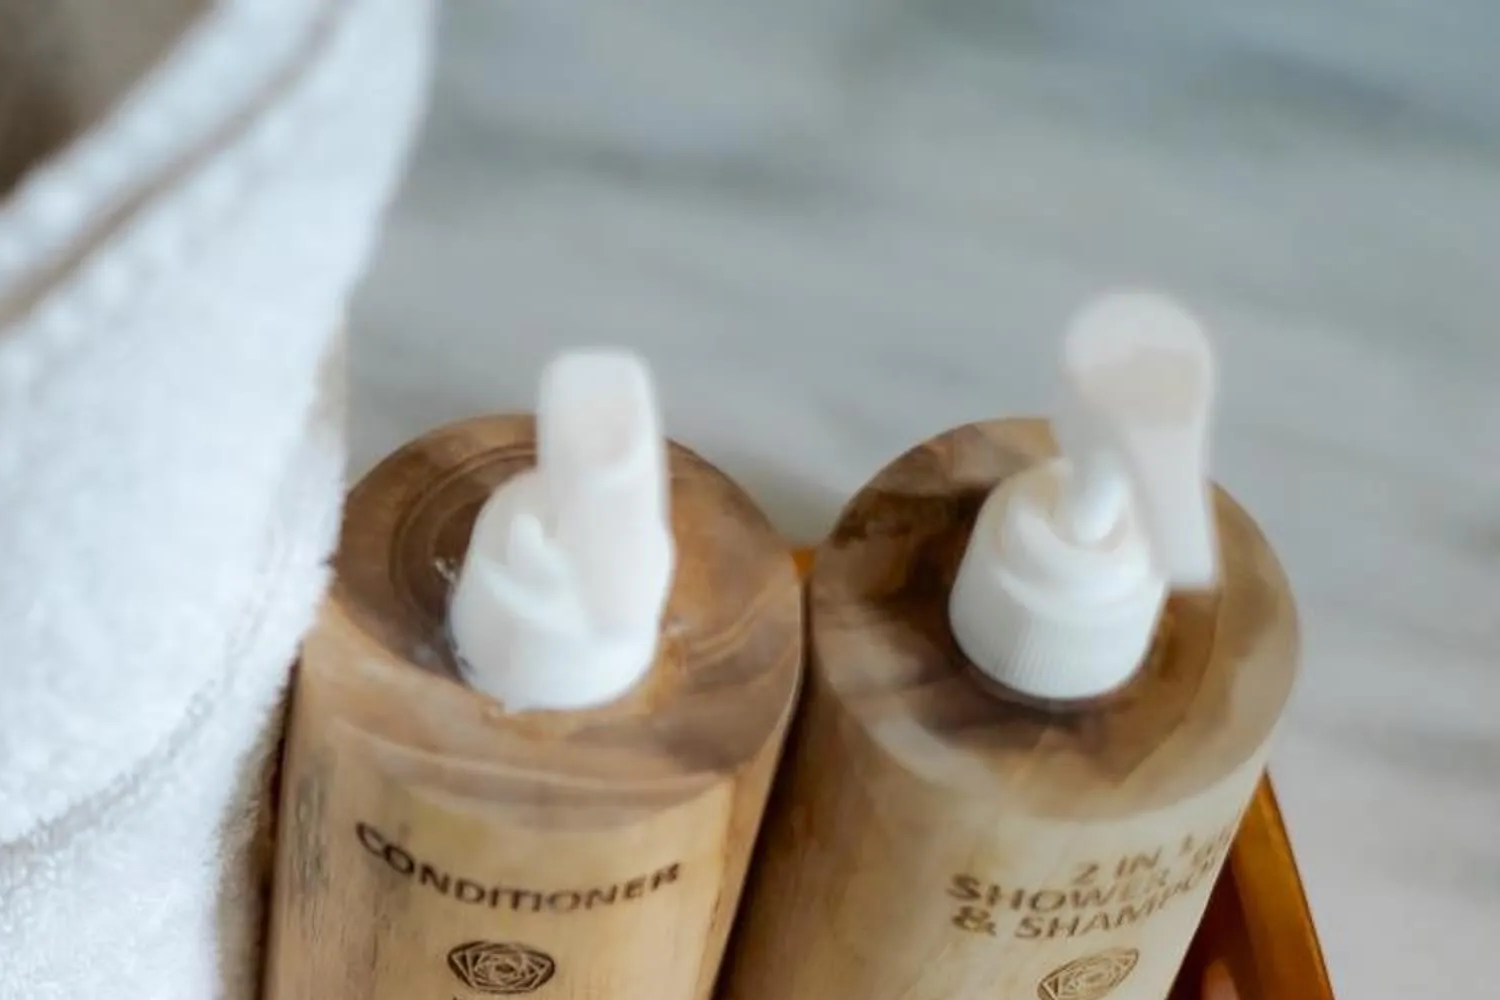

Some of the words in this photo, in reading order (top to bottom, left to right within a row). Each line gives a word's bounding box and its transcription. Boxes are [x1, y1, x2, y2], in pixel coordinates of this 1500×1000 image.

[356, 822, 681, 913] CONDITIONER
[1114, 846, 1163, 877] IN
[950, 905, 997, 937] &
